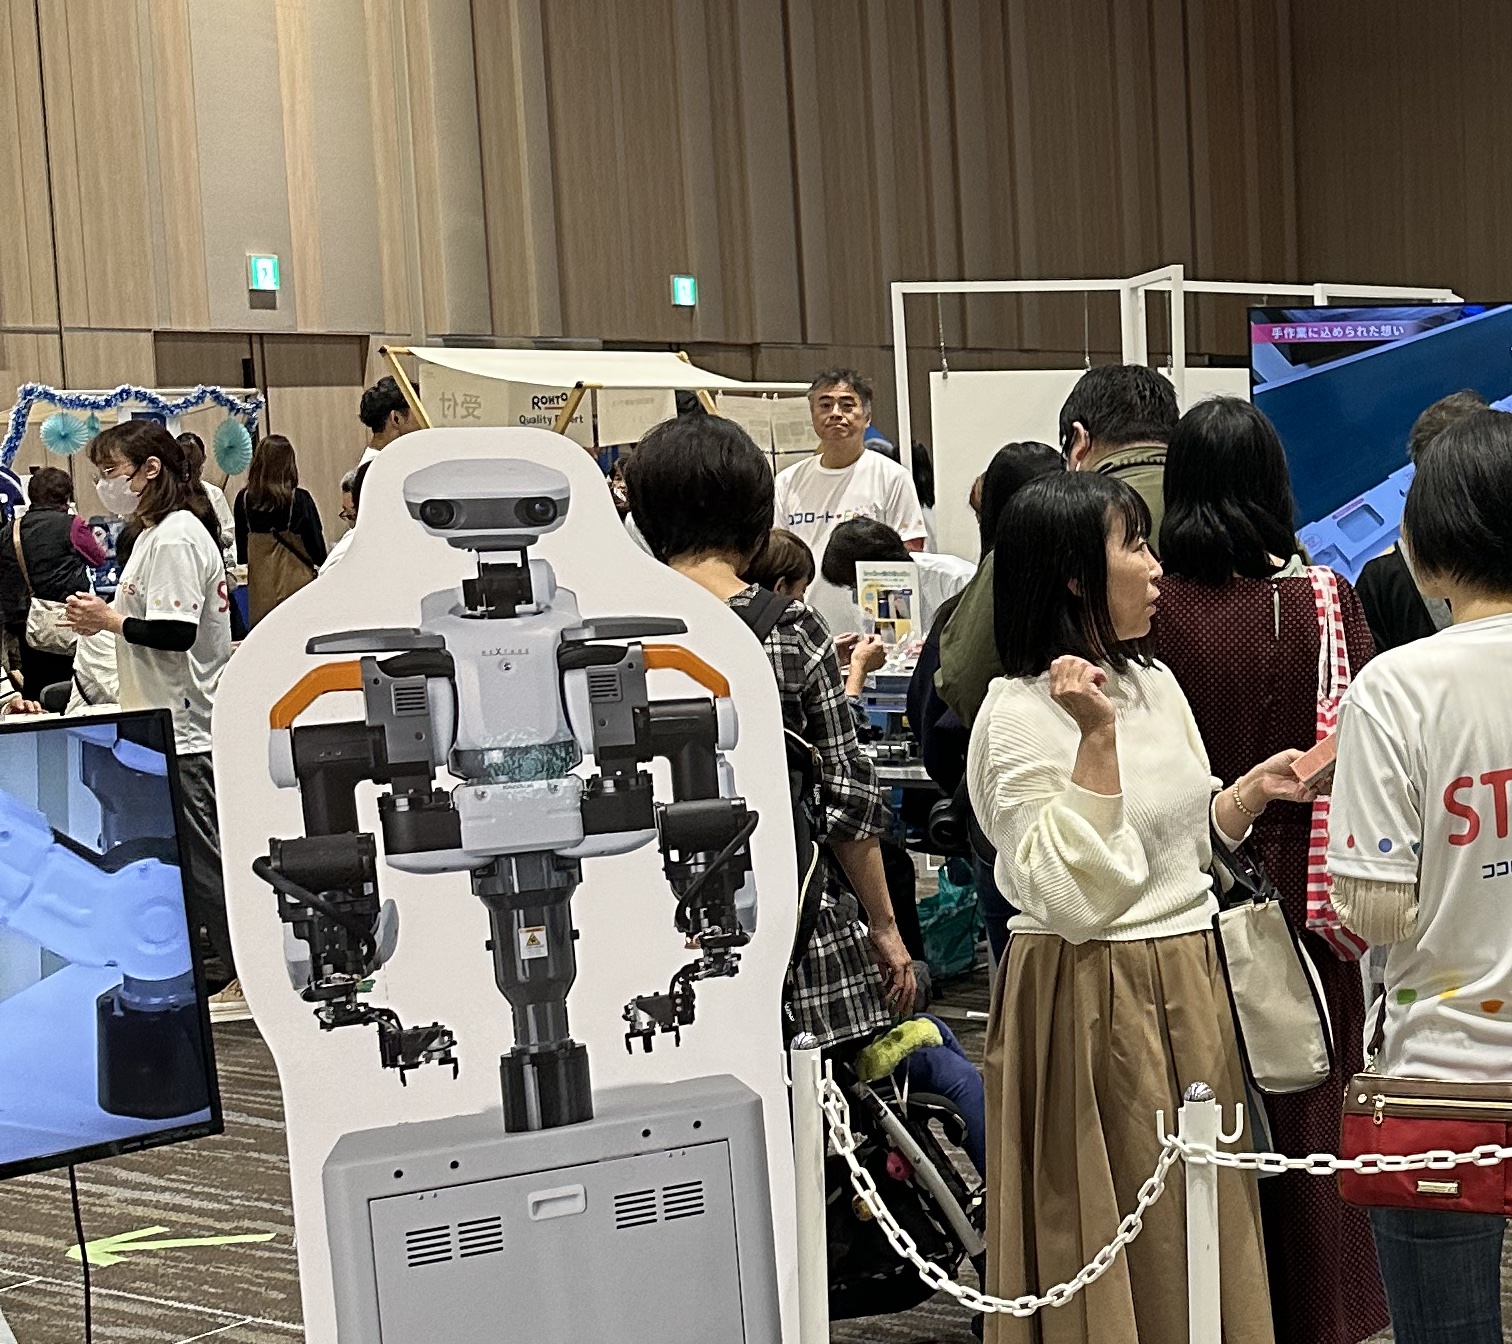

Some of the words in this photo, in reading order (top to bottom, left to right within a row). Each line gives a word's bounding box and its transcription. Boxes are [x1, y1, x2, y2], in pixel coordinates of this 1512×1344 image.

[1271, 324, 1404, 340] 手作業に込められた想い
[532, 392, 568, 410] ROHTO
[519, 414, 552, 426] Quality
